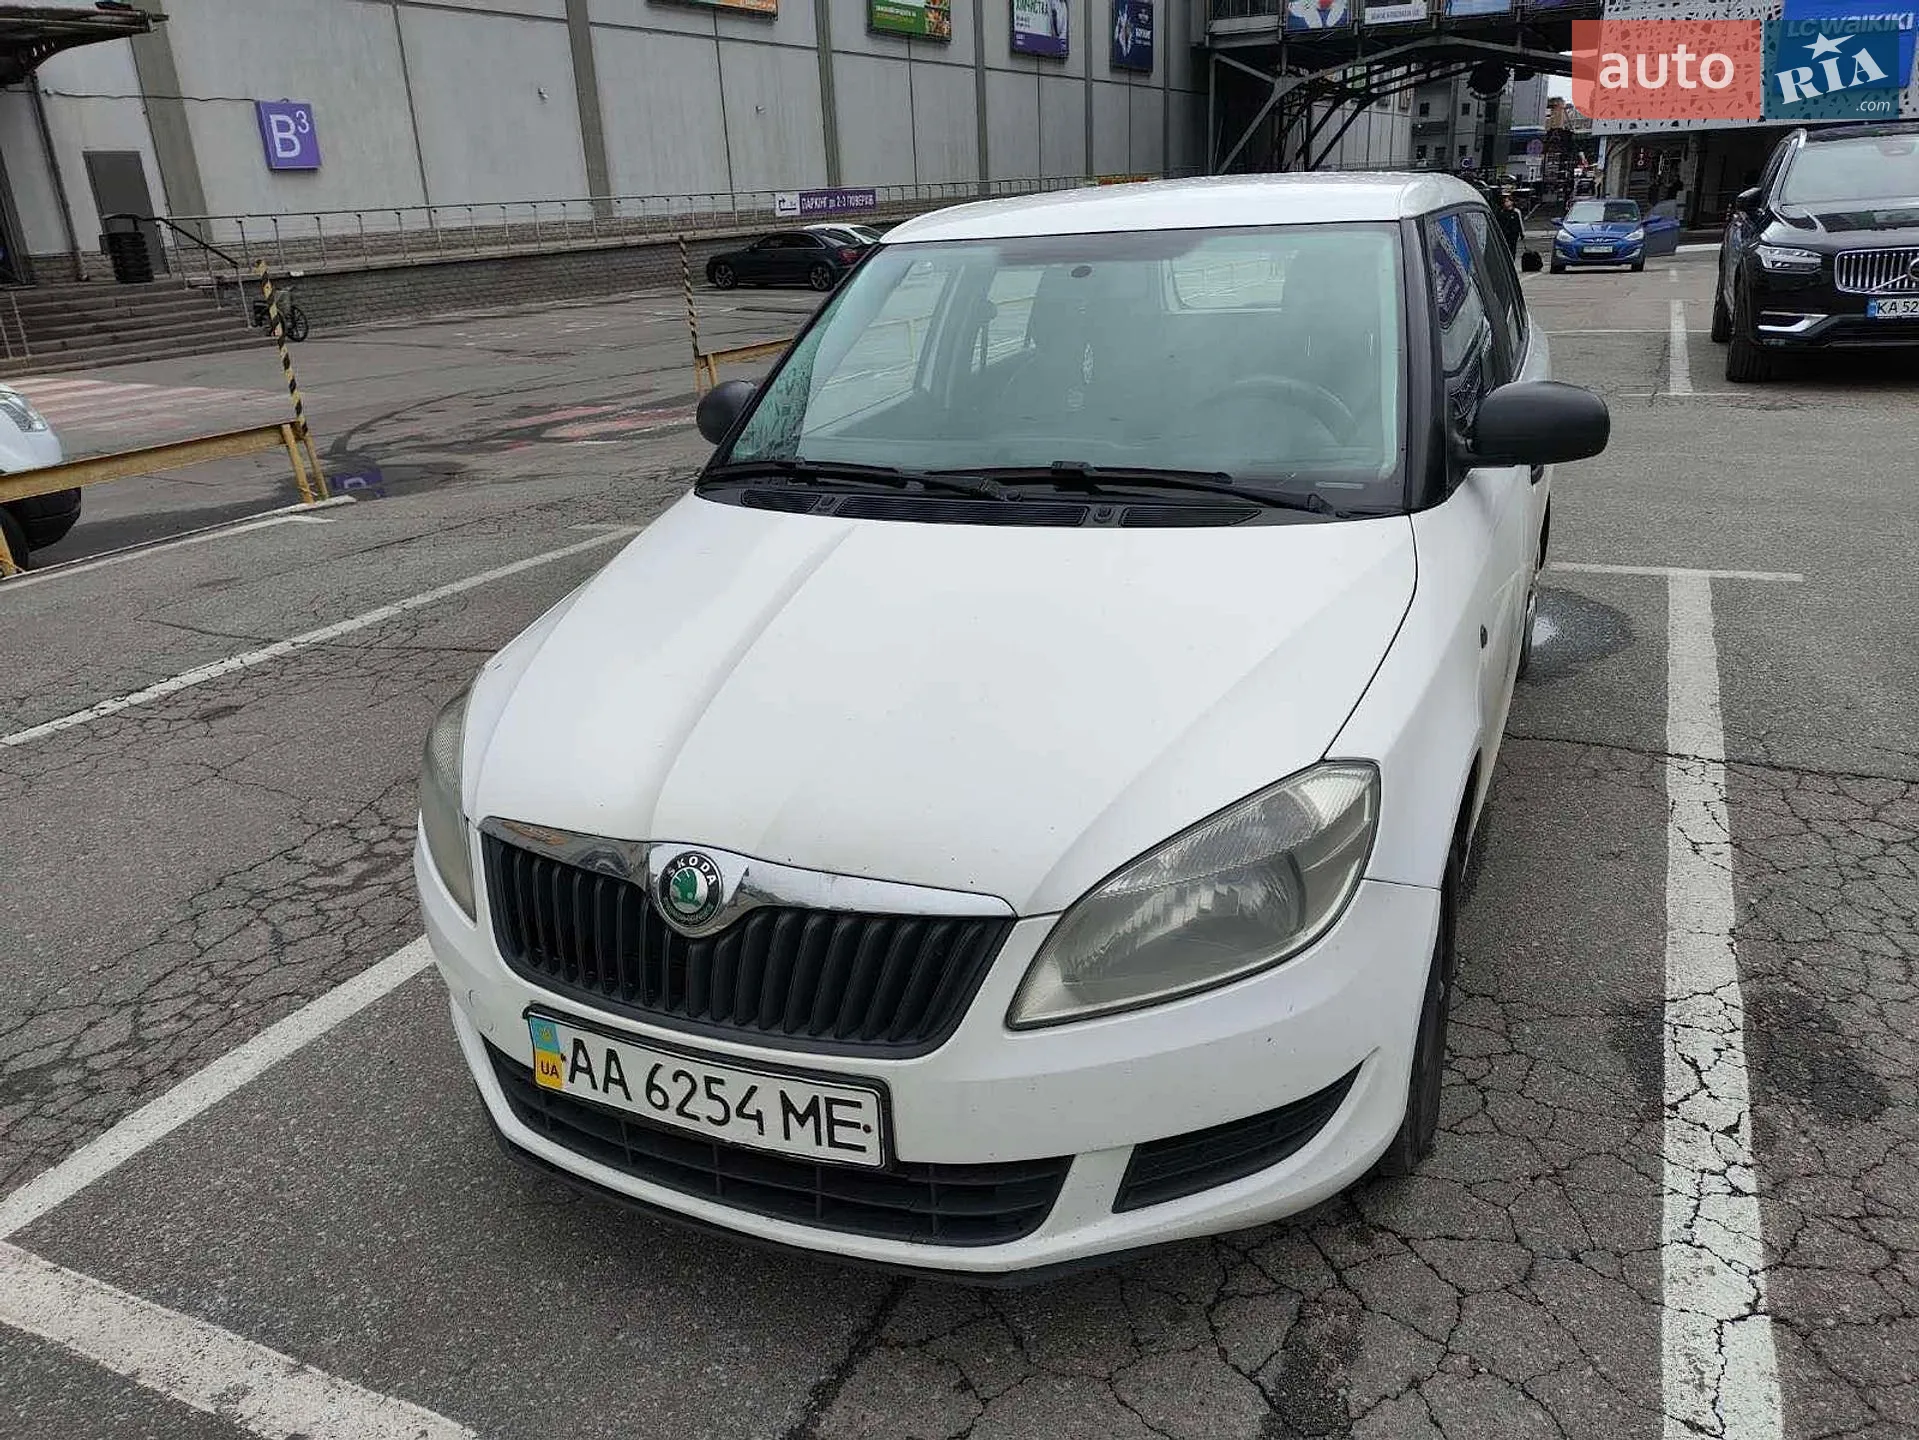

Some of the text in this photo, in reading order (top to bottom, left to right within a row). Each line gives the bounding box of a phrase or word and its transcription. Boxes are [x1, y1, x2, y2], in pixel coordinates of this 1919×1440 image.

[1786, 18, 1818, 37] LC
[1877, 301, 1898, 314] KA
[1902, 300, 1919, 313] 52
[541, 1061, 559, 1078] UA
[568, 1038, 867, 1152] AA 6254 ME
